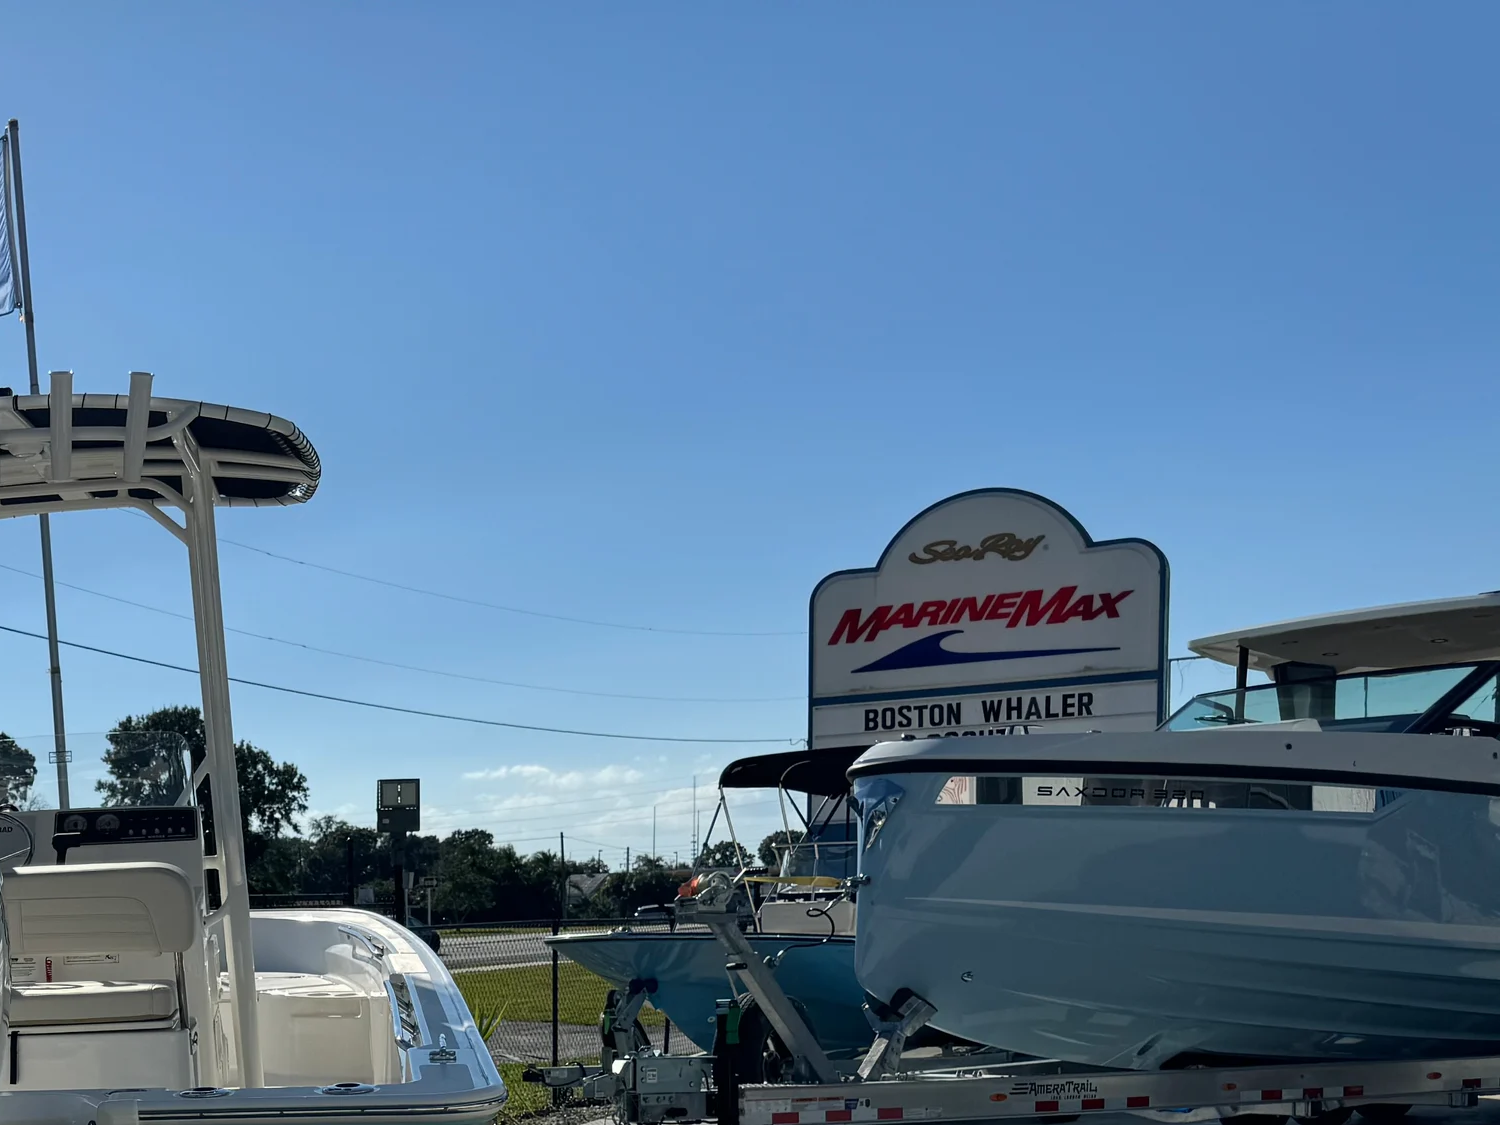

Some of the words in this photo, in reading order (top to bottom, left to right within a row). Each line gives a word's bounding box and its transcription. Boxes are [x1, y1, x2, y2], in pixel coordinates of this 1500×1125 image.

[908, 540, 972, 565] Sea
[973, 532, 1046, 562] Ray
[864, 702, 962, 731] BOSTON
[981, 692, 1094, 723] WHALER
